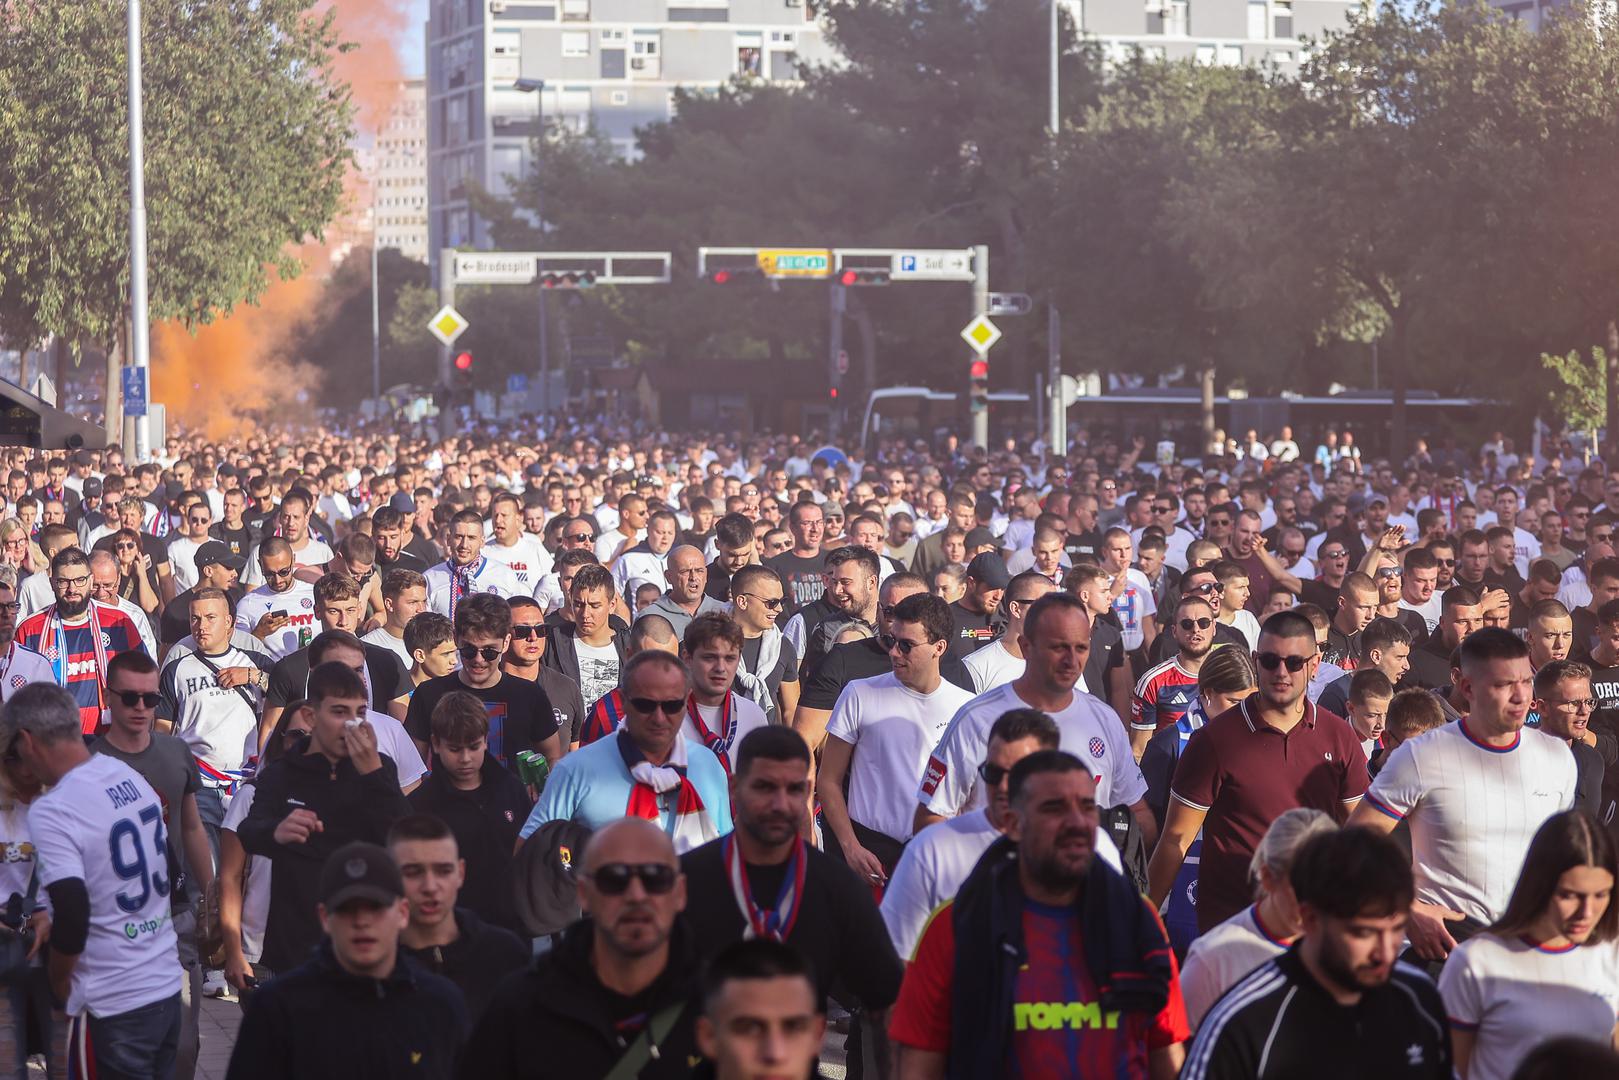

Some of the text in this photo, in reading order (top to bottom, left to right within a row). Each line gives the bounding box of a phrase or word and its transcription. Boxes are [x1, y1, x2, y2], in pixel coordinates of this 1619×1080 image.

[185, 673, 218, 696] HAJ
[209, 689, 236, 697] SPLIT
[105, 778, 143, 810] JRADI
[109, 802, 170, 914] 93
